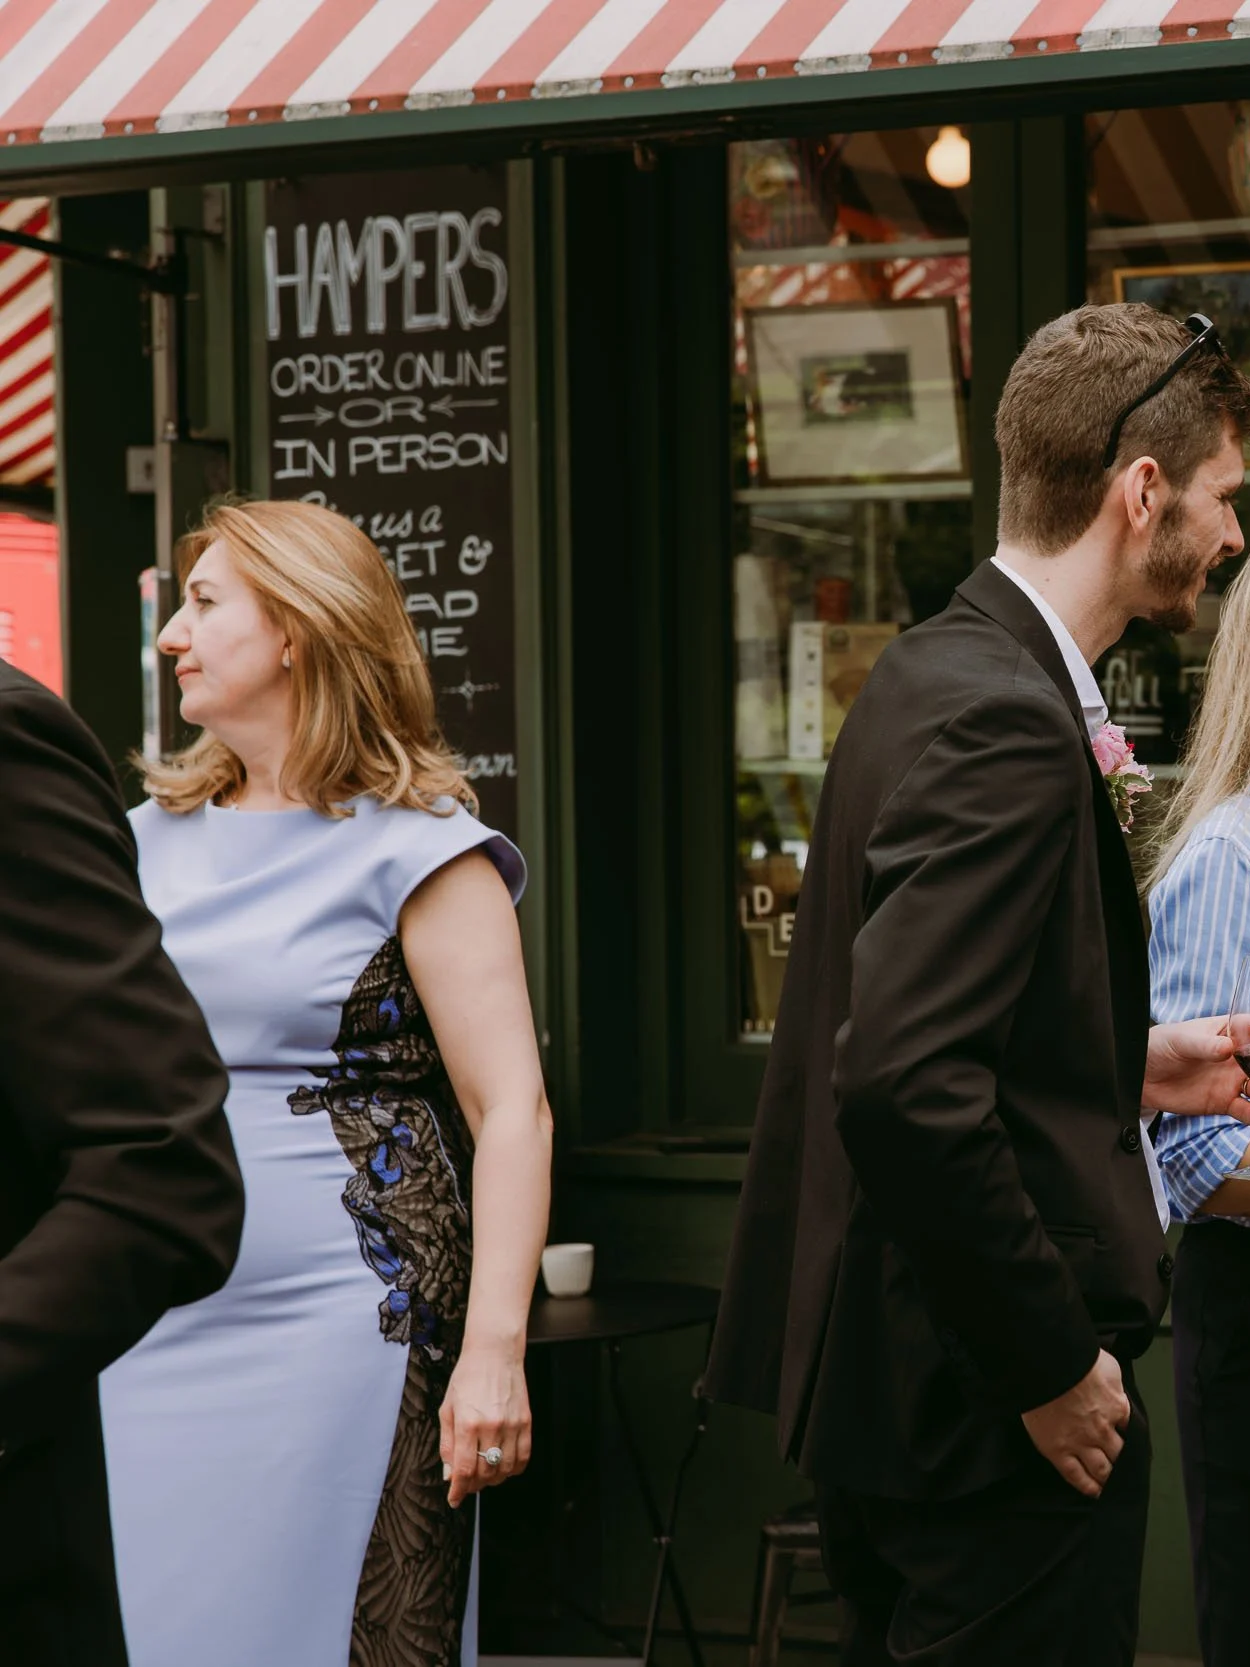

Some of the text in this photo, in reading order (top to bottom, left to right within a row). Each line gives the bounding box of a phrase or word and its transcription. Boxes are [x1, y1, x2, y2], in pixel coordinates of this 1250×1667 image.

[265, 207, 508, 341] HAMPERS
[270, 346, 508, 397] ORDER ONLINE
[338, 396, 426, 427] OR
[273, 431, 508, 480] IN PERSON
[418, 504, 443, 533] a
[458, 534, 493, 575] &
